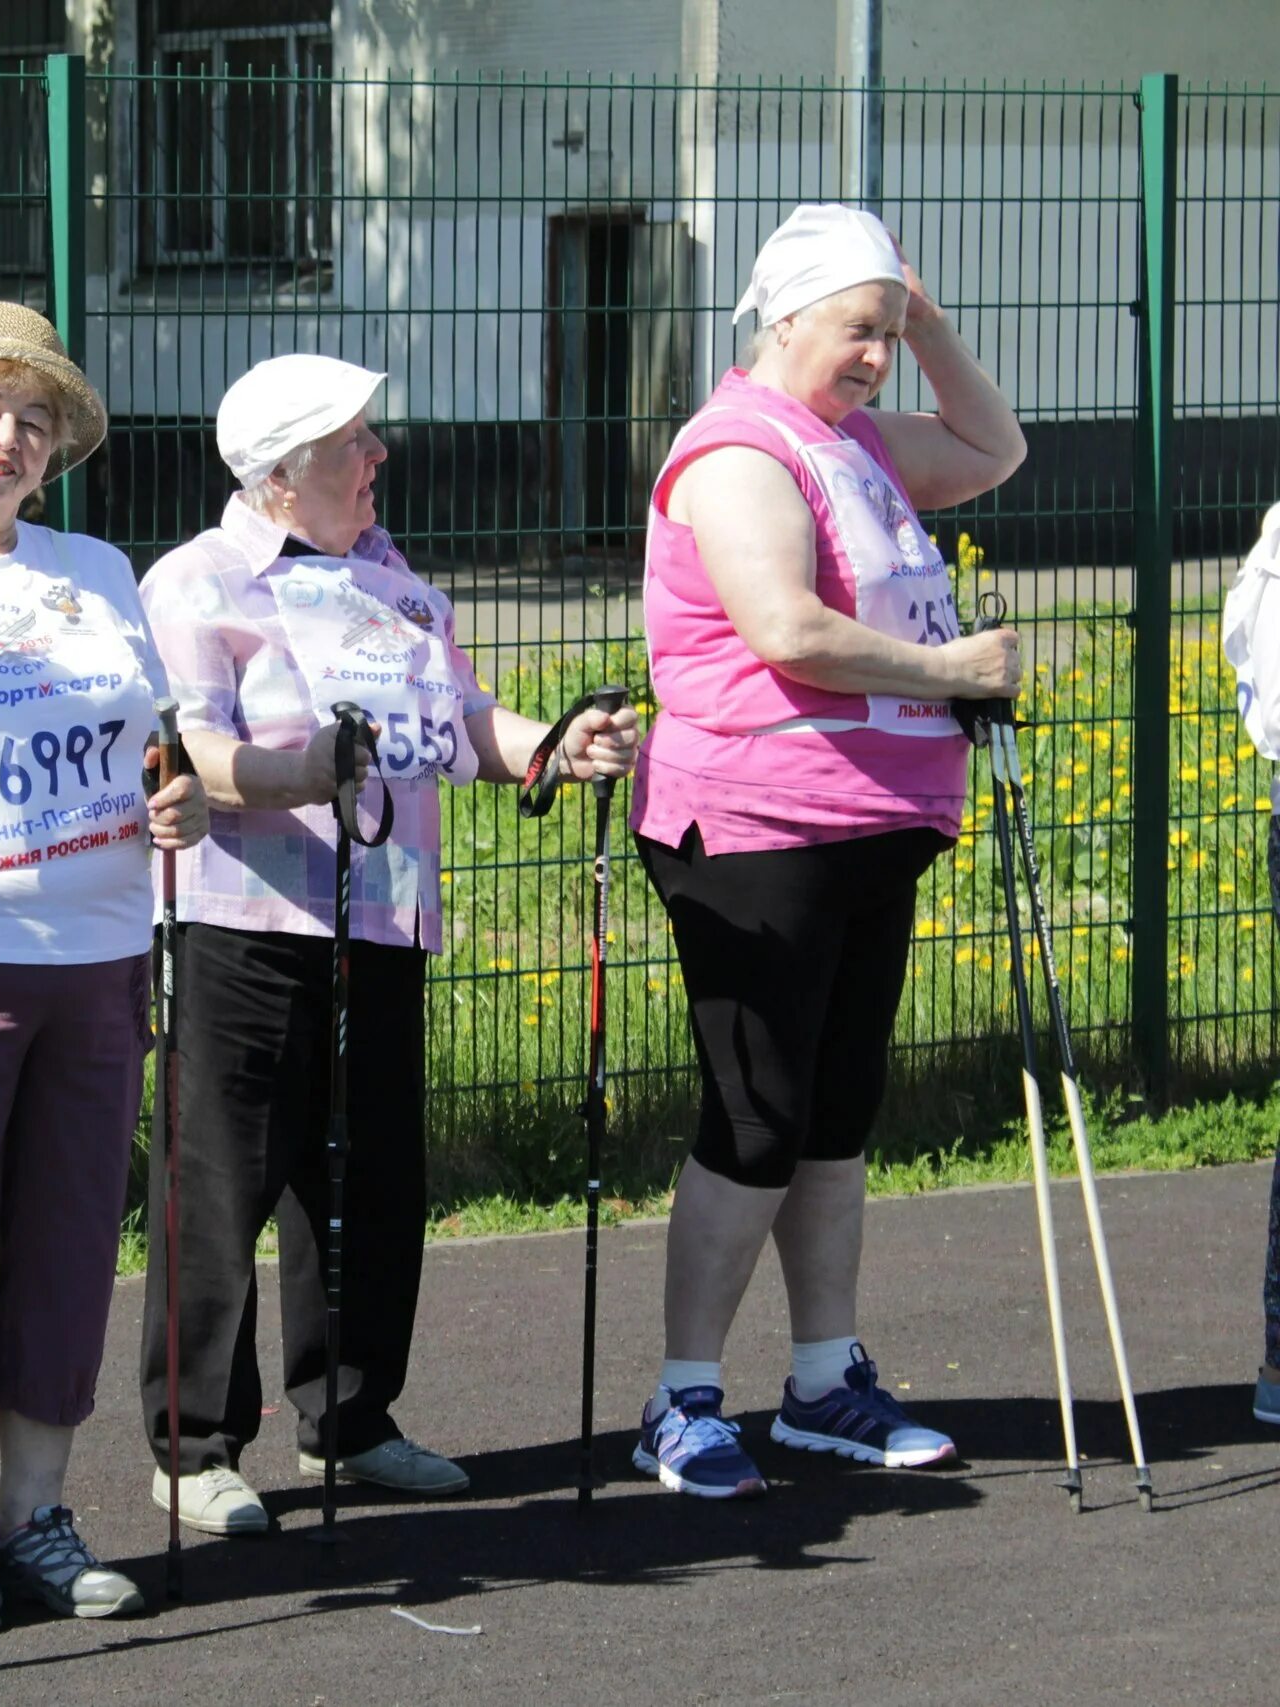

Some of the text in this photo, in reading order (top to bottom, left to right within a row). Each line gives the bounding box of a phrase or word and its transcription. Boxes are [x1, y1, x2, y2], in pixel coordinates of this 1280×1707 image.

[355, 646, 418, 665] РОССИИ
[47, 830, 109, 861] РОССИИ
[118, 821, 139, 842] 2016
